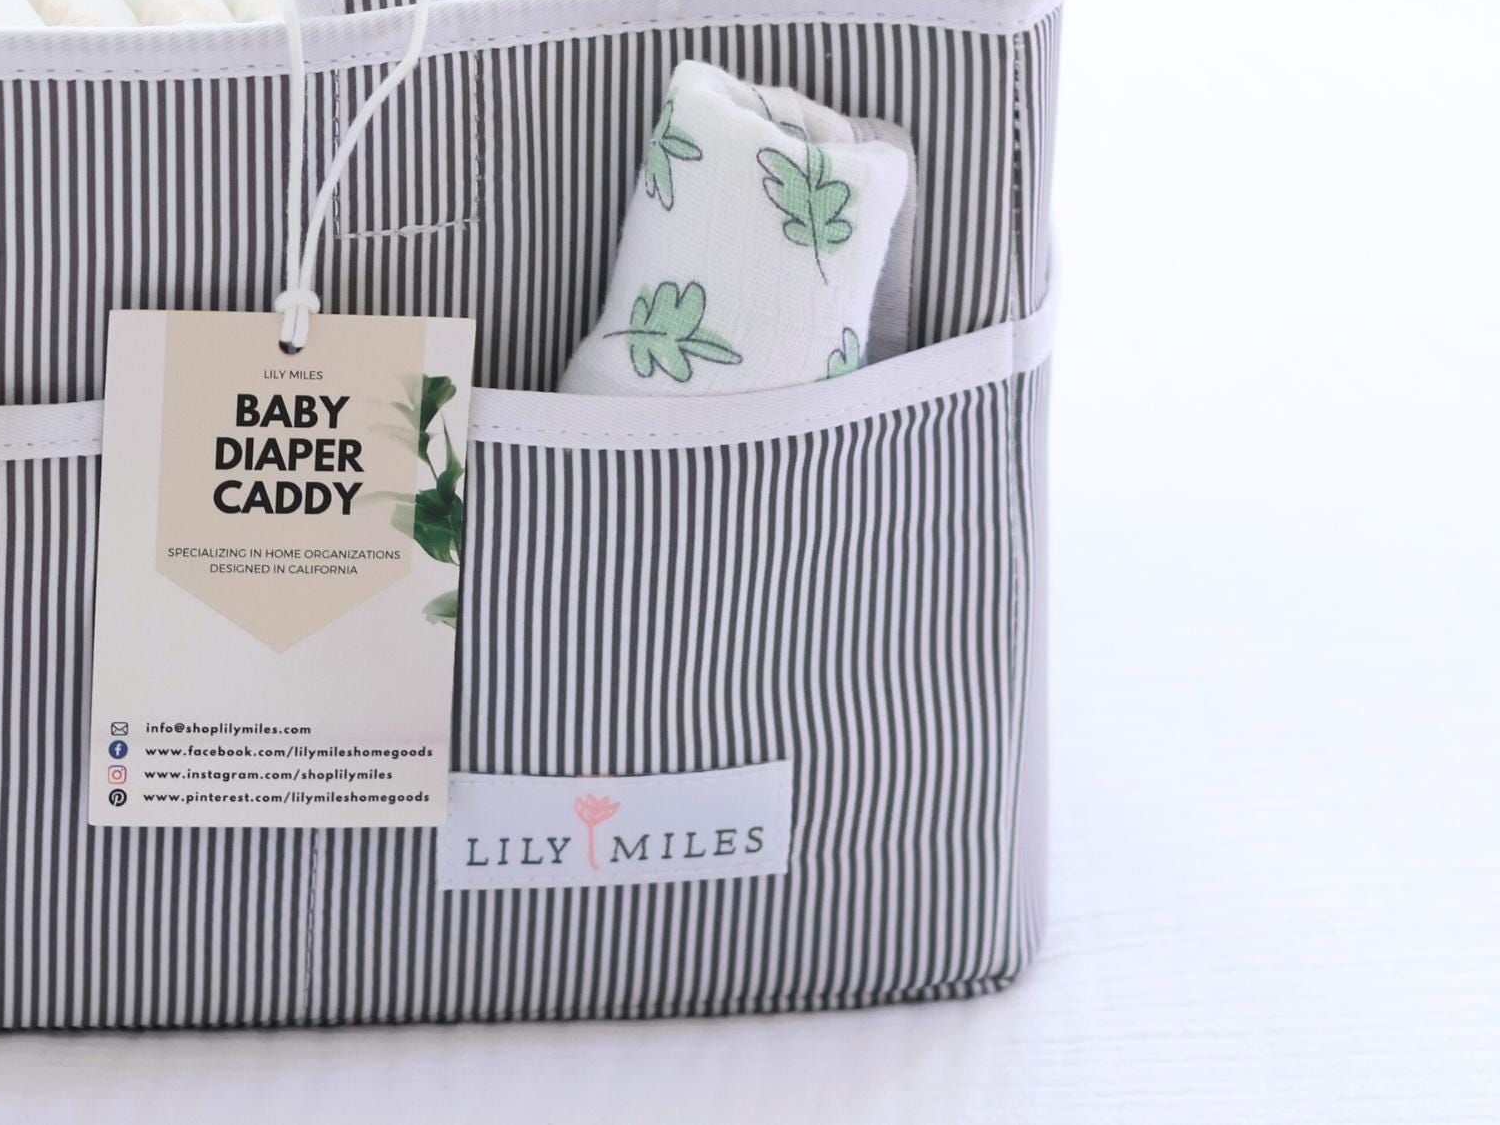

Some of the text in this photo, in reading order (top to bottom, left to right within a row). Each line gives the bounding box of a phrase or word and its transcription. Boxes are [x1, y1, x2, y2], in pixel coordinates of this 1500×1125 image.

[263, 369, 324, 380] LILY MILES
[235, 393, 351, 429] BABY
[214, 436, 365, 473] DIAPER
[212, 479, 364, 516] CADDY
[167, 547, 401, 560] SPECIALIZING IN HOME ORGANIZATIONS
[209, 563, 359, 575] DESIGNED IN CALIFORNIA
[145, 721, 312, 737] info@shoplilymiles.com
[145, 744, 434, 760] www.facebook.com/lilymileshomegoods
[144, 767, 393, 783] www.instagram.com/shoplilymiles
[143, 790, 431, 806] www.pinterest.com/lilymileshomegoods
[466, 826, 764, 867] LILY MILES
